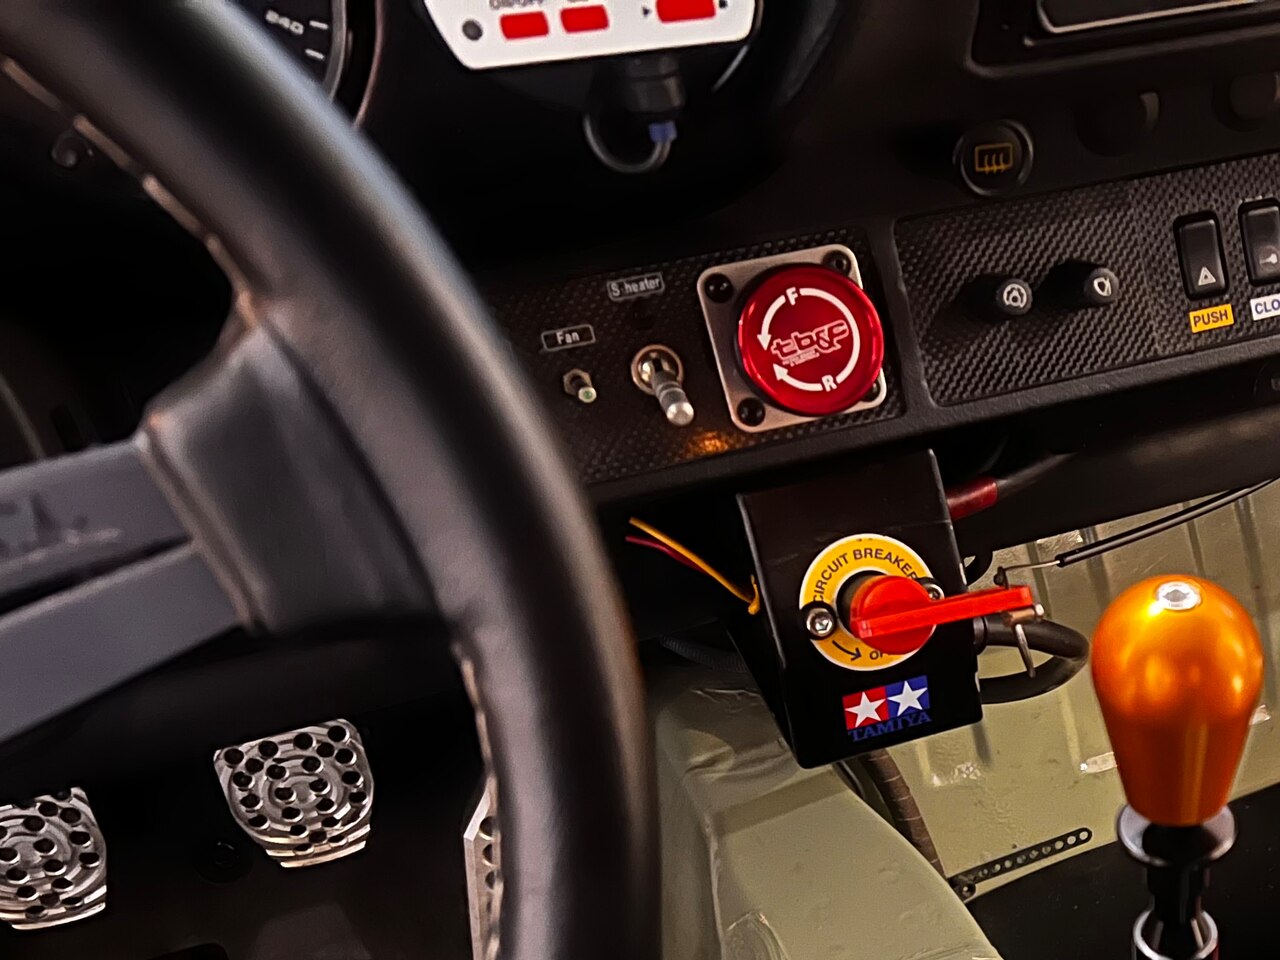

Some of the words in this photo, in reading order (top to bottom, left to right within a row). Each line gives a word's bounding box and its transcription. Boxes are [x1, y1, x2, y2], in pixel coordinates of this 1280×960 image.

[785, 286, 798, 306] F
[1193, 309, 1229, 327] PUSH
[555, 331, 580, 345] Fan
[821, 374, 837, 392] R
[848, 710, 932, 742] TAMIYA
